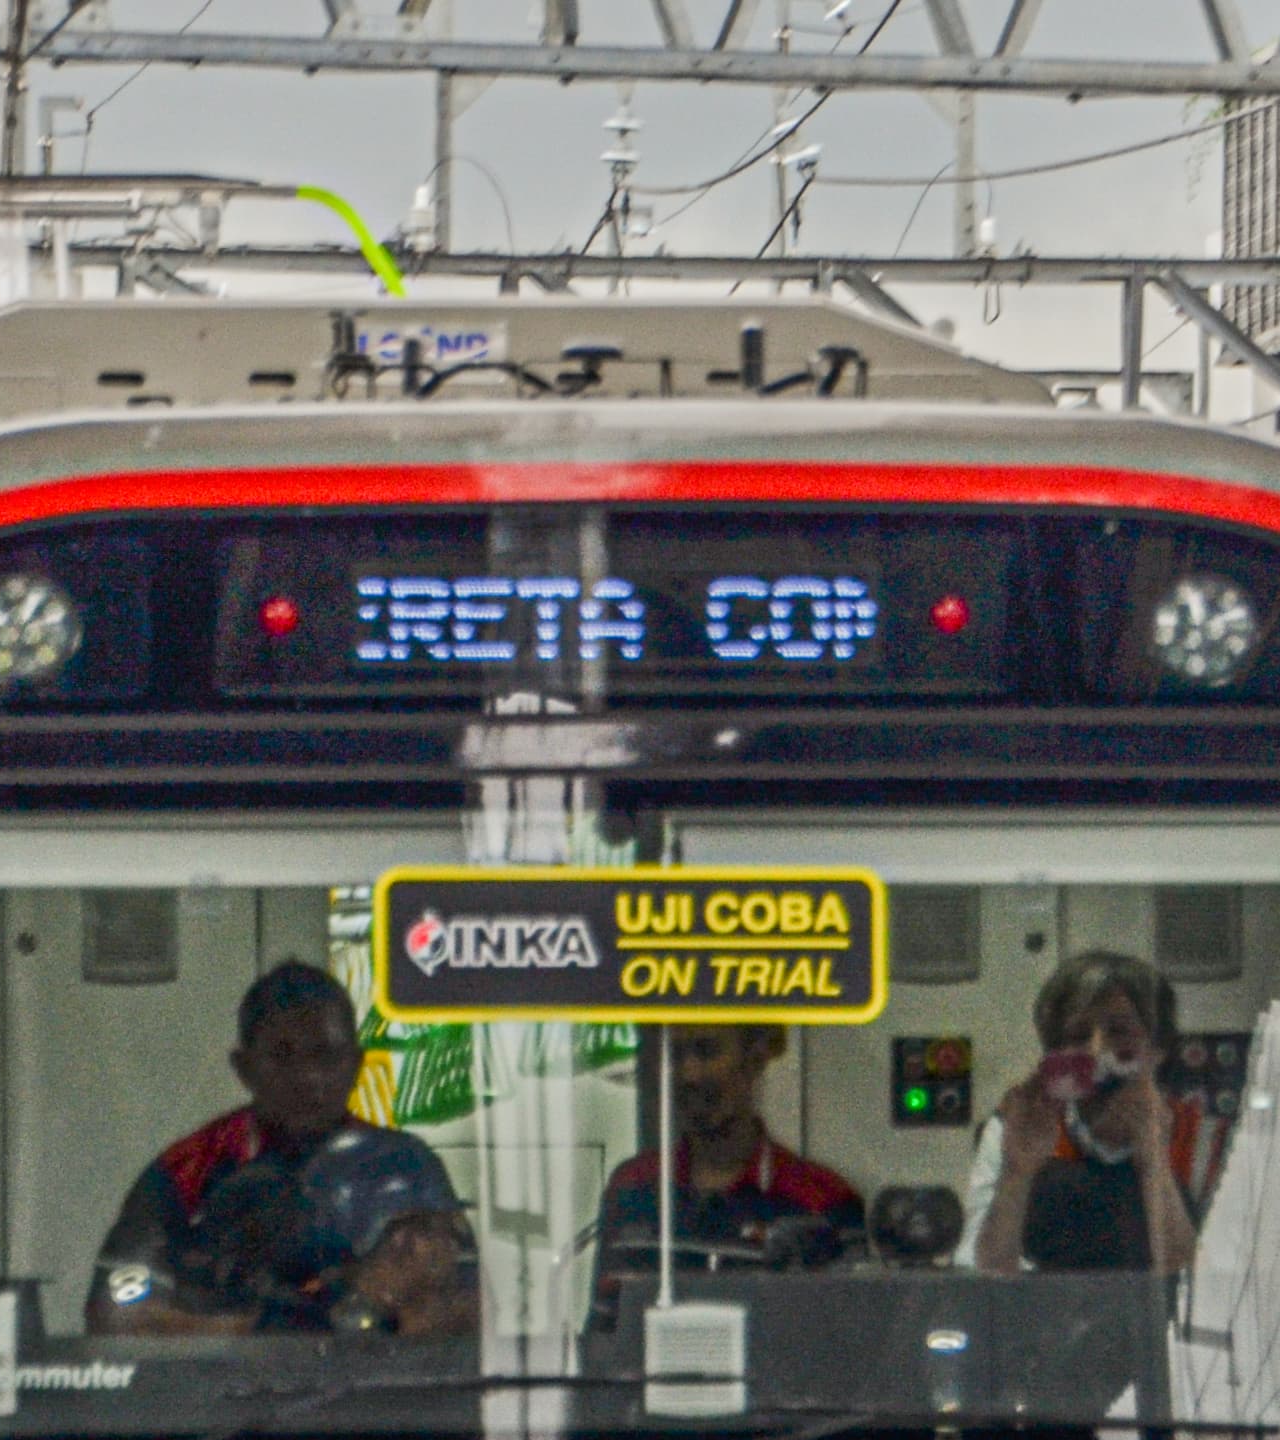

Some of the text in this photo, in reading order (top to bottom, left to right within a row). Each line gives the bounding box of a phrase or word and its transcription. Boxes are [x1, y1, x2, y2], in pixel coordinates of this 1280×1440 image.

[615, 891, 849, 935] UJI COBA
[449, 915, 599, 969] INKA
[620, 956, 844, 999] ON TRIAL
